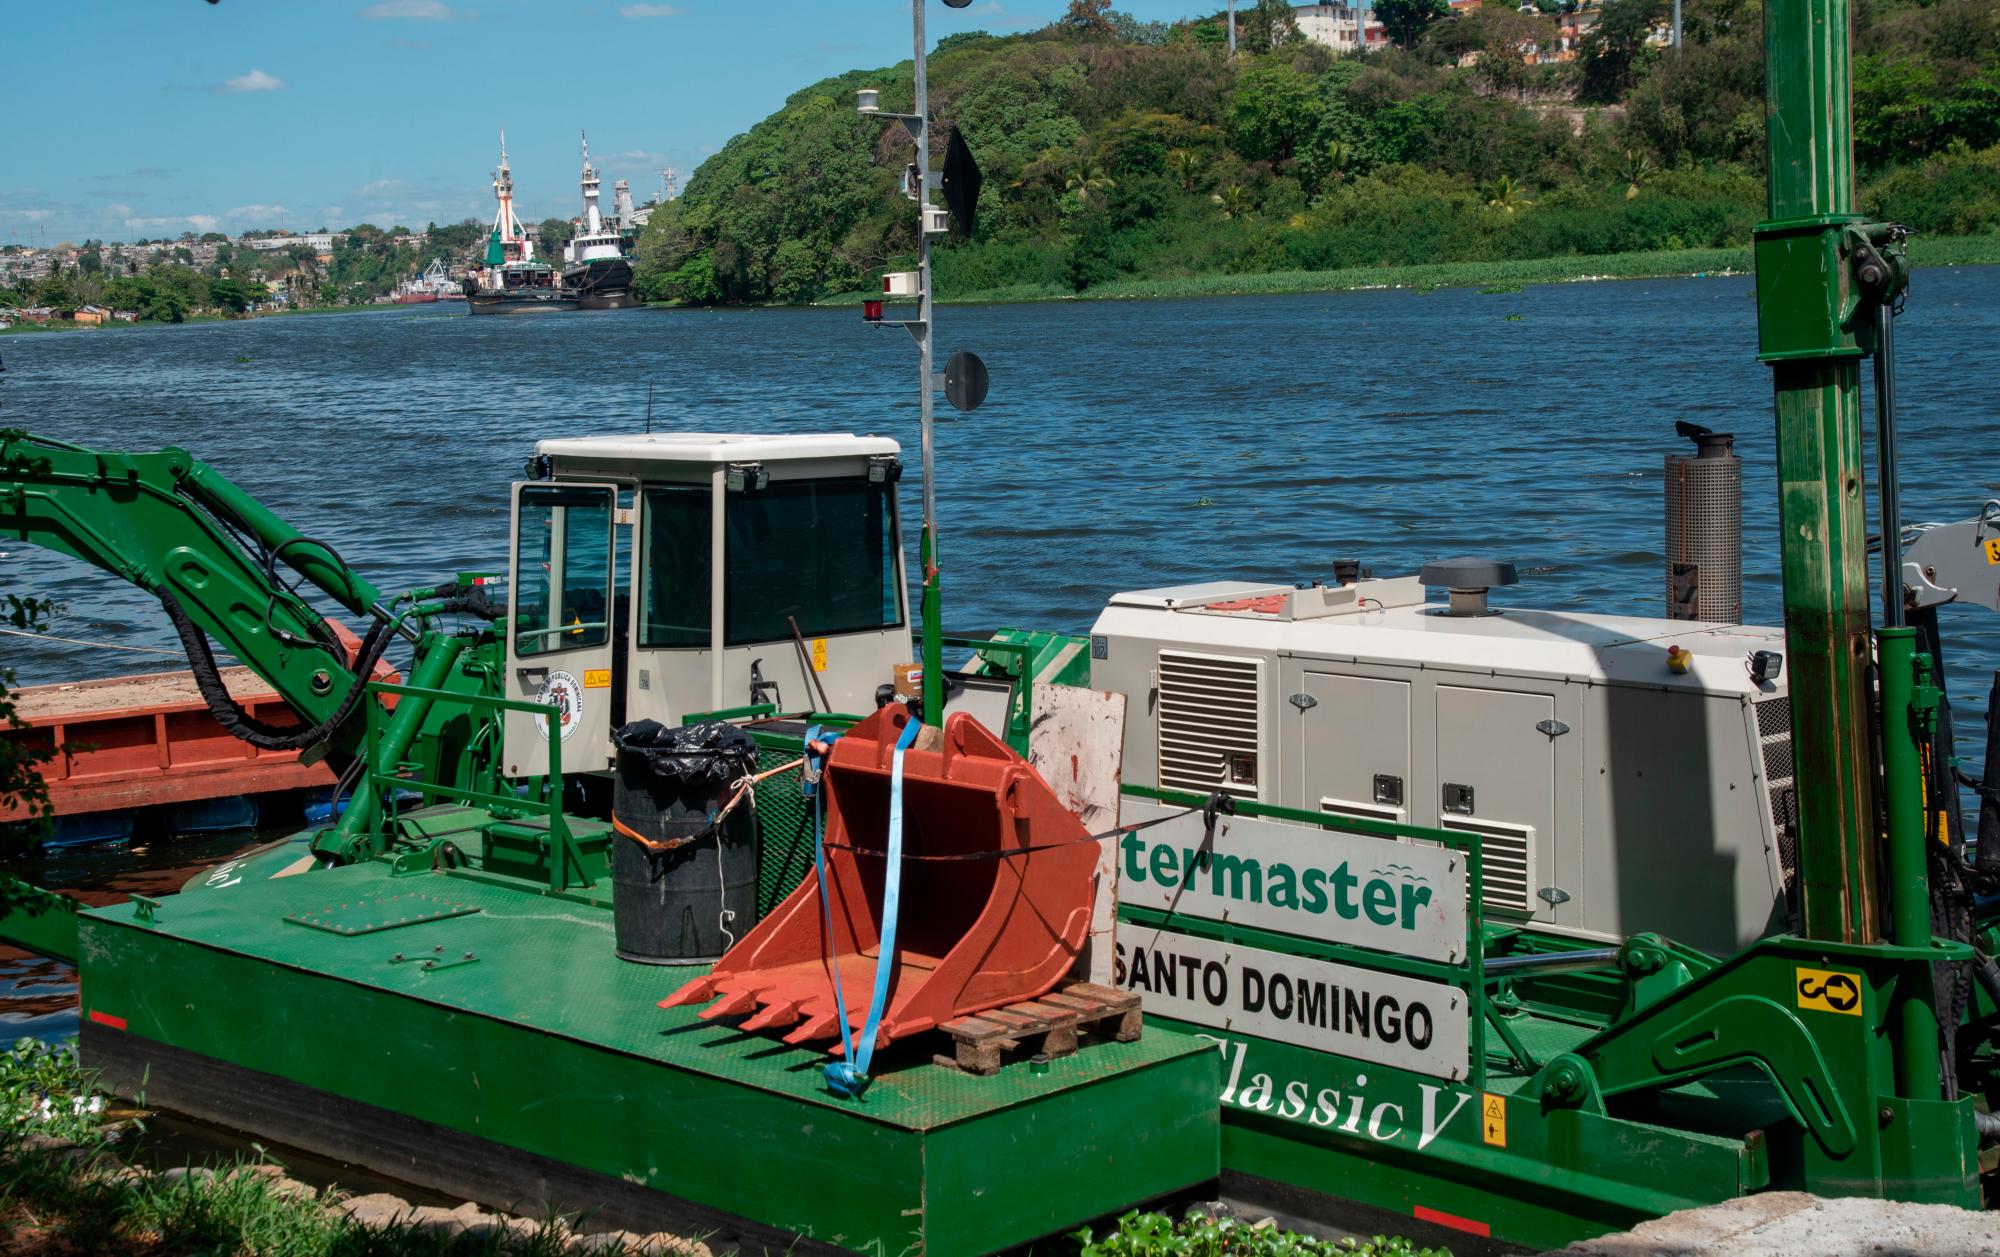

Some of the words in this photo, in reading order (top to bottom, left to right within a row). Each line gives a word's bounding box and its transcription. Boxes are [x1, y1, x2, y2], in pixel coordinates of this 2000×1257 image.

[570, 679, 583, 713] DOMINICANA
[1118, 830, 1433, 930] termaster
[1116, 942, 1228, 1006] SANTO
[1243, 967, 1433, 1050] DOMINGO
[1418, 1083, 1472, 1150] V
